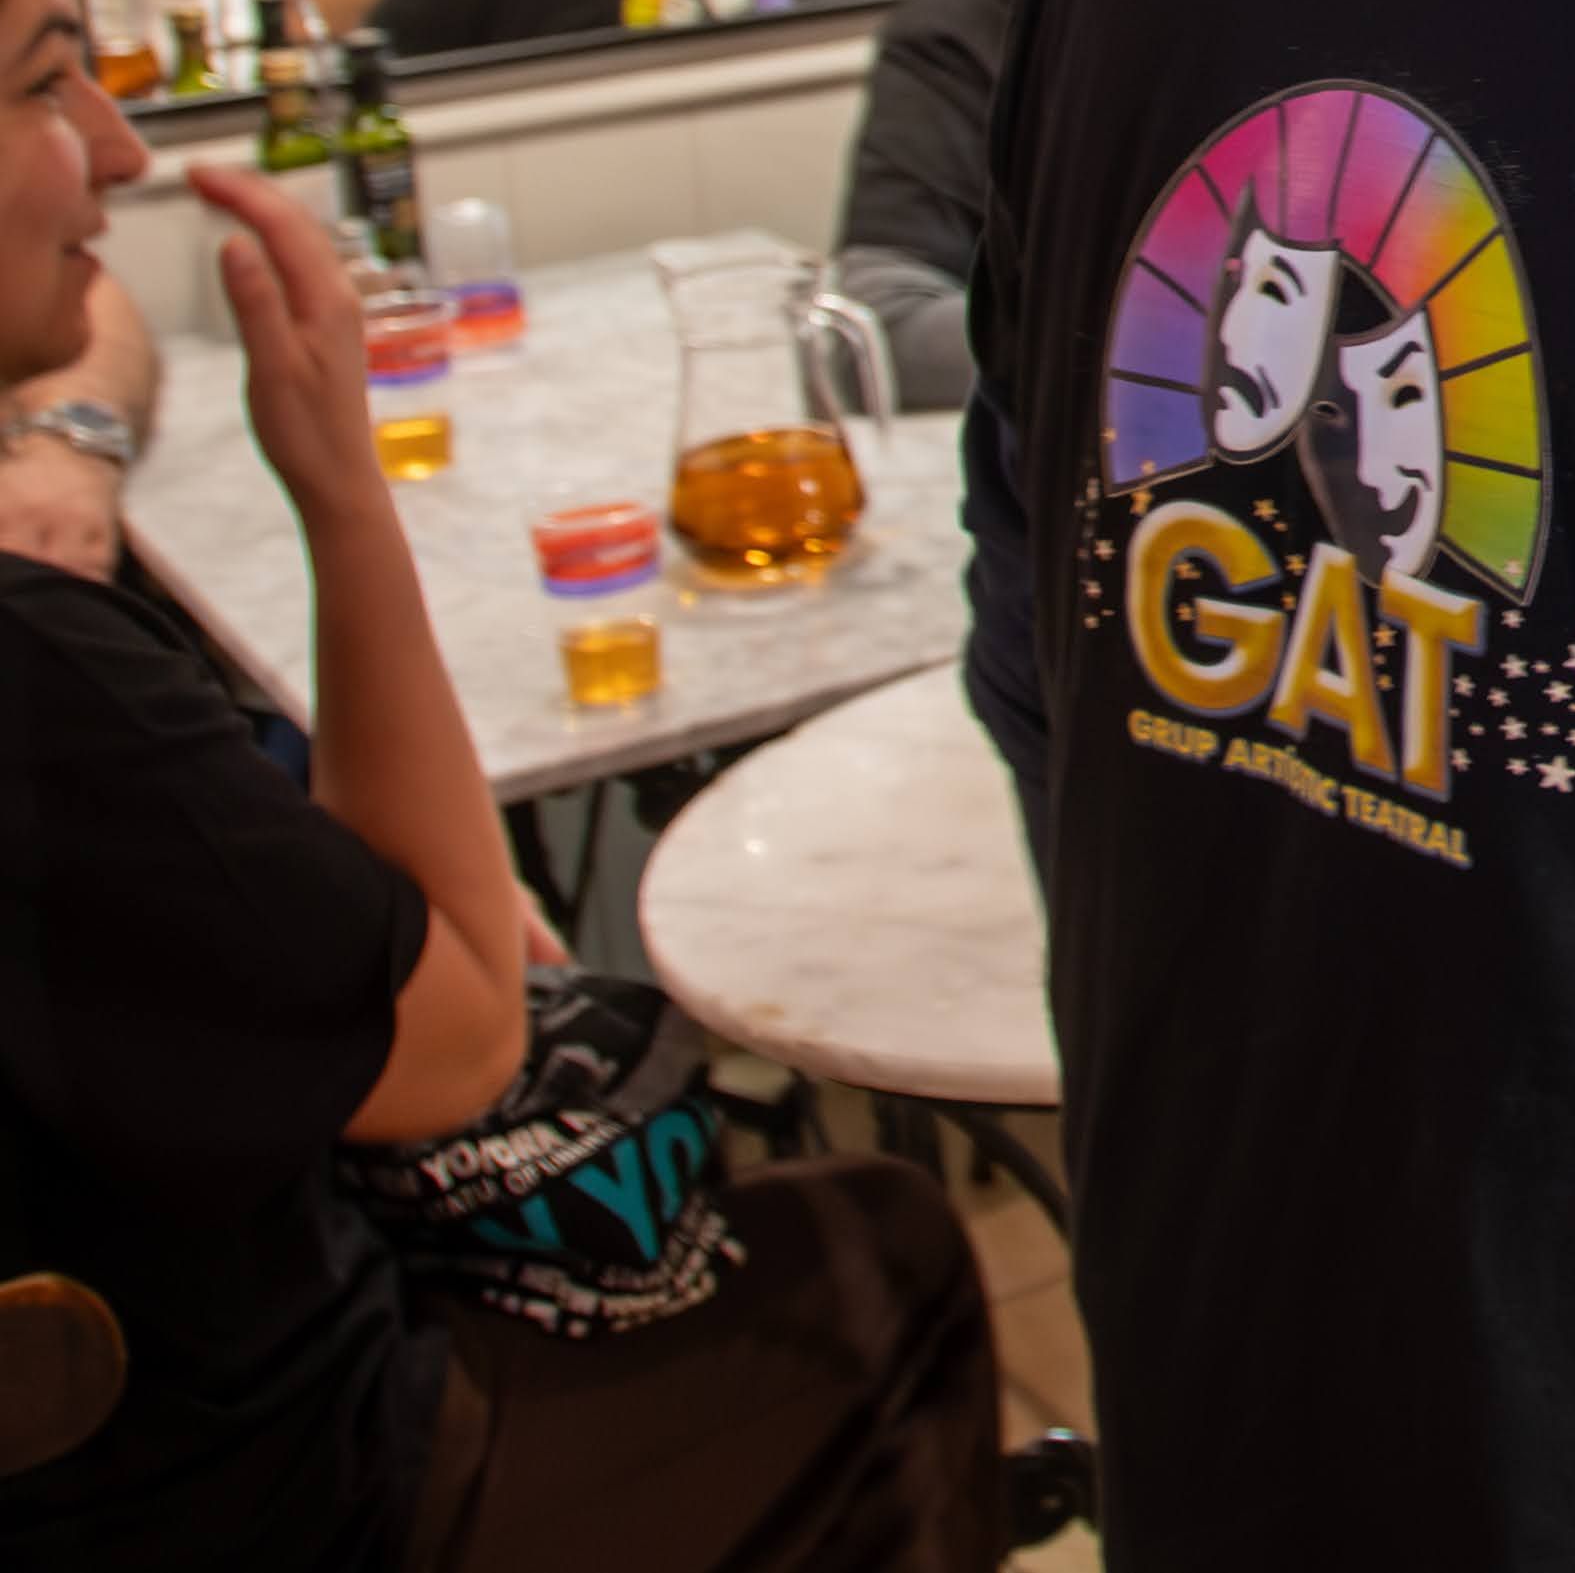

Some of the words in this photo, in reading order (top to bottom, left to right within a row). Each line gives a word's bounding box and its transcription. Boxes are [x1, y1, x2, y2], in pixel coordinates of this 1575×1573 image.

[1128, 501, 1486, 799] GAT
[1128, 708, 1219, 763] GRUP
[1342, 785, 1471, 868] TEATRAL
